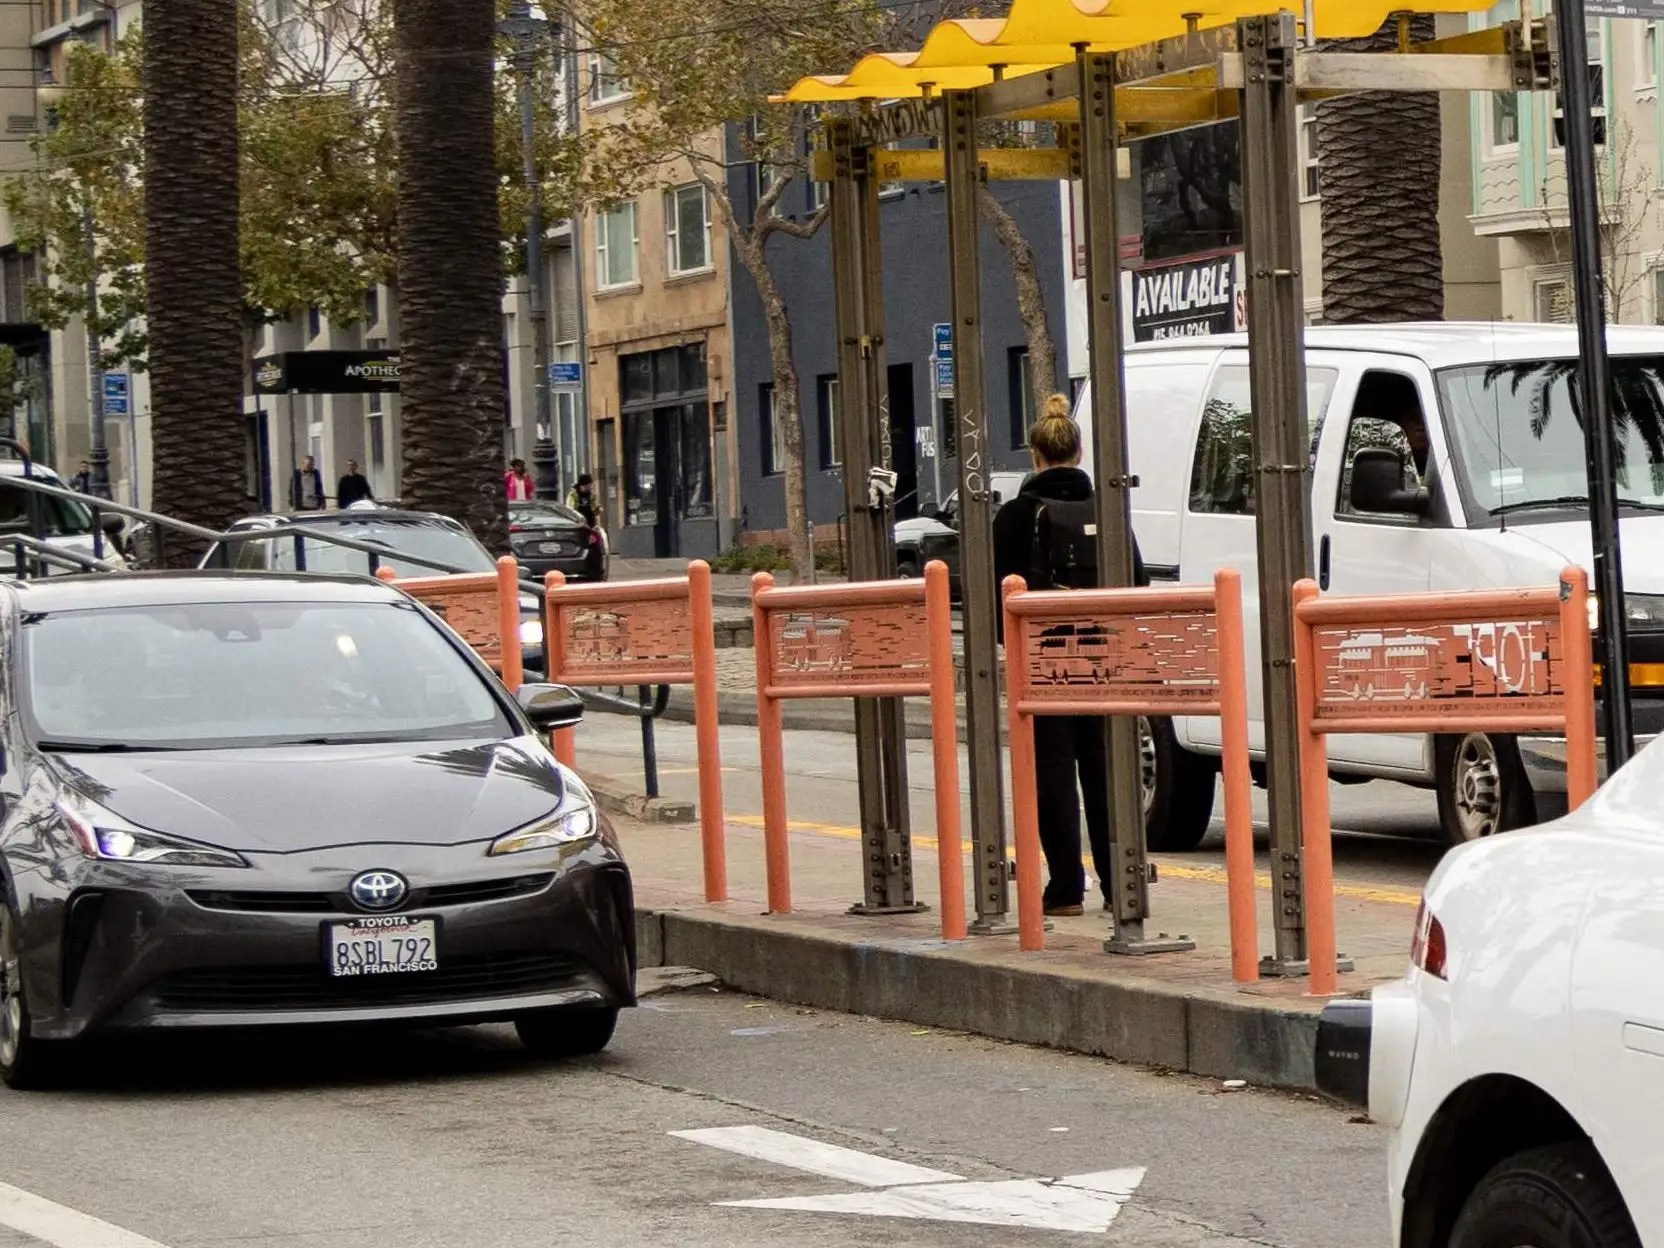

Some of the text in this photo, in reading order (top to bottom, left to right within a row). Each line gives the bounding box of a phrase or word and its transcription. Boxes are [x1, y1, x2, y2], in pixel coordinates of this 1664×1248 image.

[1136, 262, 1230, 317] AVAILABLE
[359, 916, 409, 928] TOYOTA
[337, 937, 432, 967] 8SBL792
[333, 960, 438, 977] SAN FRANCISCO
